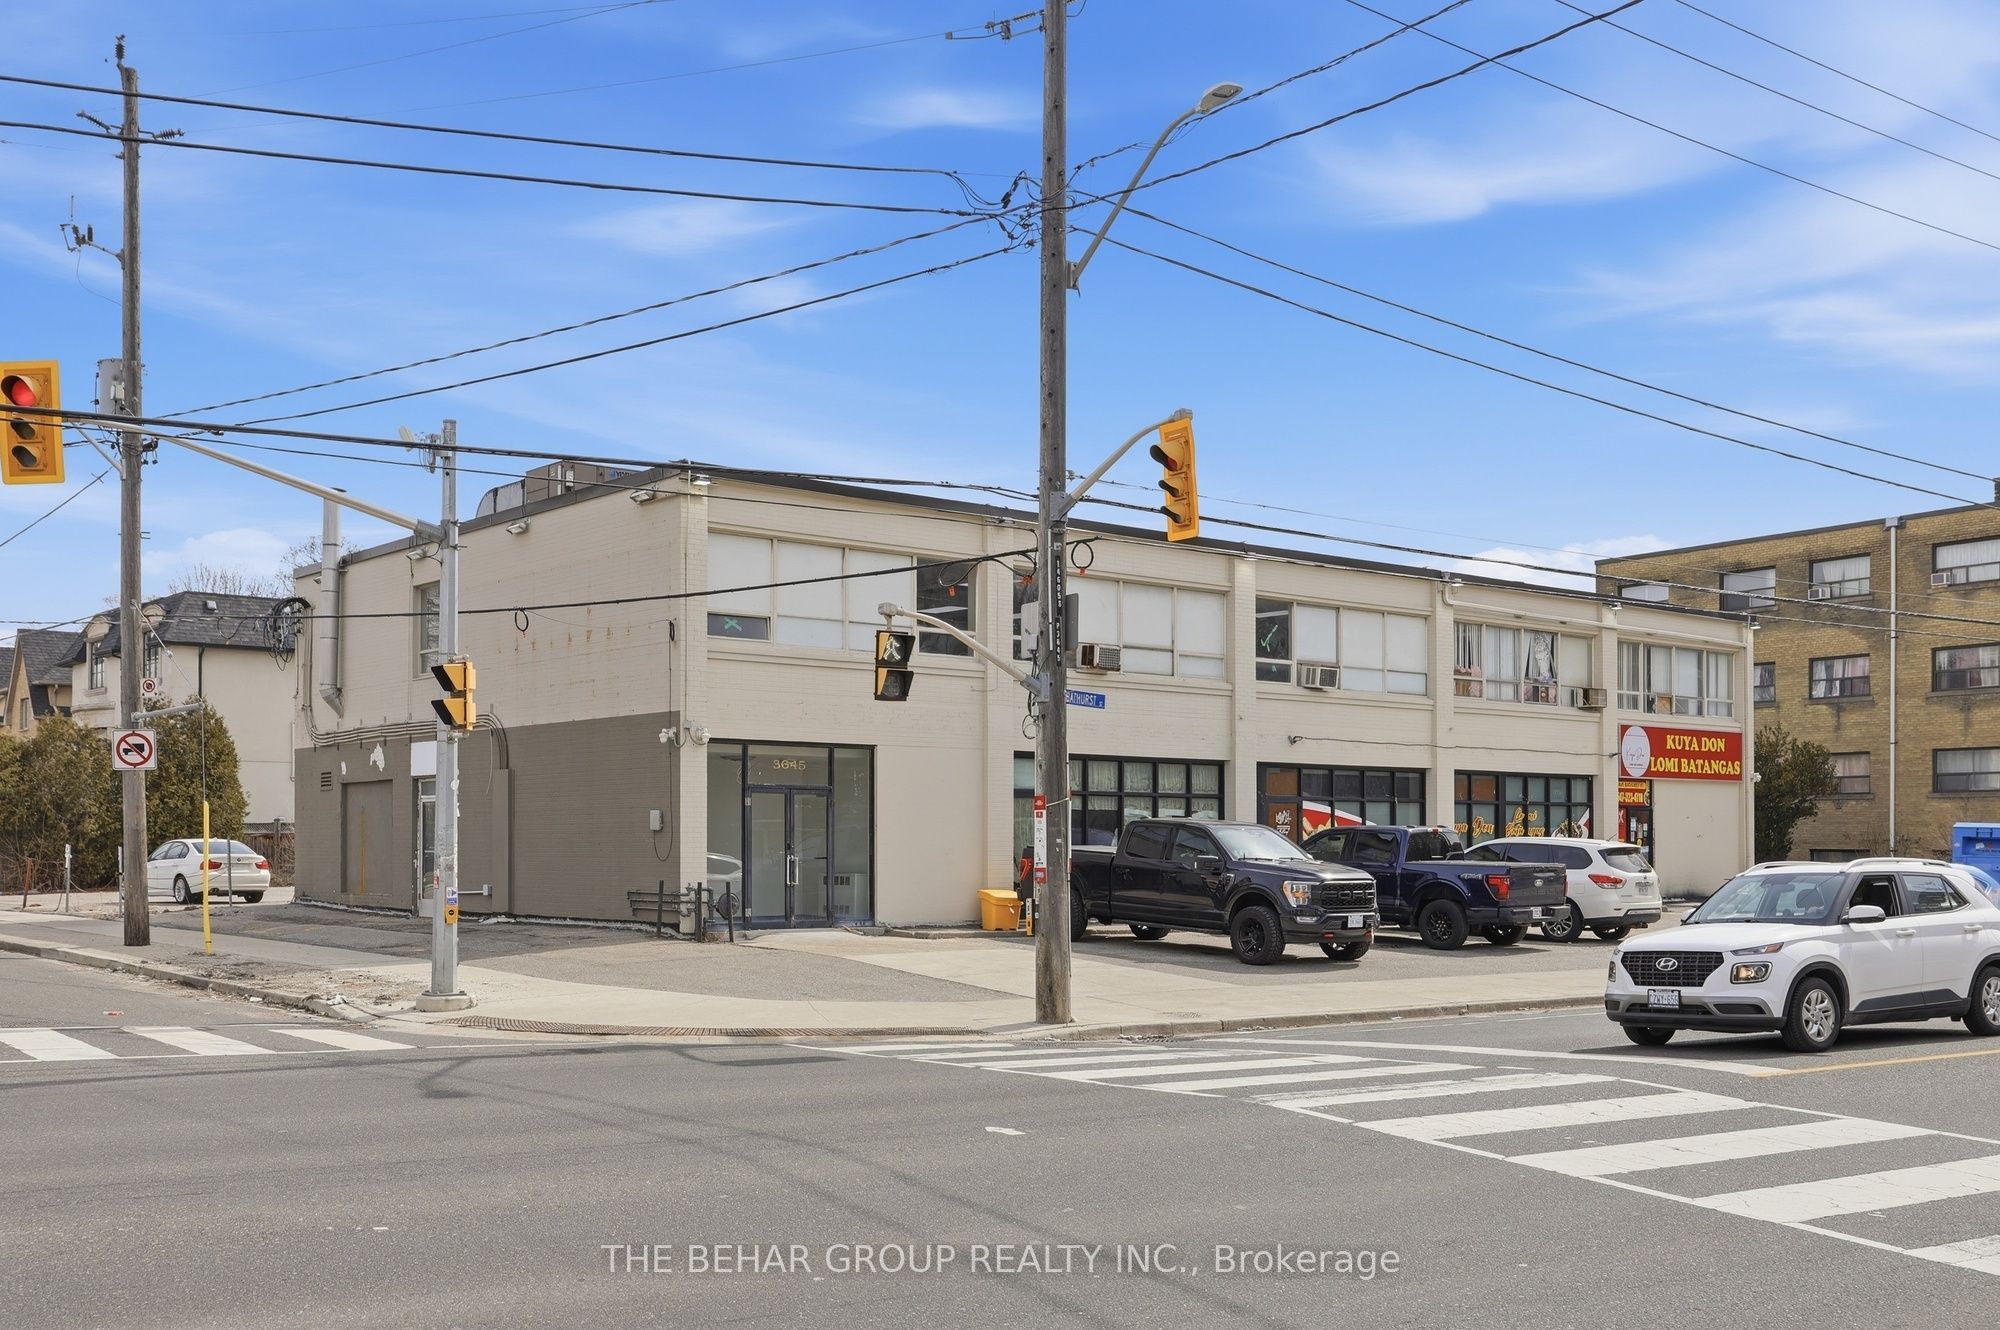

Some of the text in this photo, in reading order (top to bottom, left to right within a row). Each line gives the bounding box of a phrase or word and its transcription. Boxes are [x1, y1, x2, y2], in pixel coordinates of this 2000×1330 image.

[1666, 735, 1725, 752] KUYA DON
[773, 760, 806, 770] 3645
[1650, 757, 1741, 775] LOMI BATANGAS
